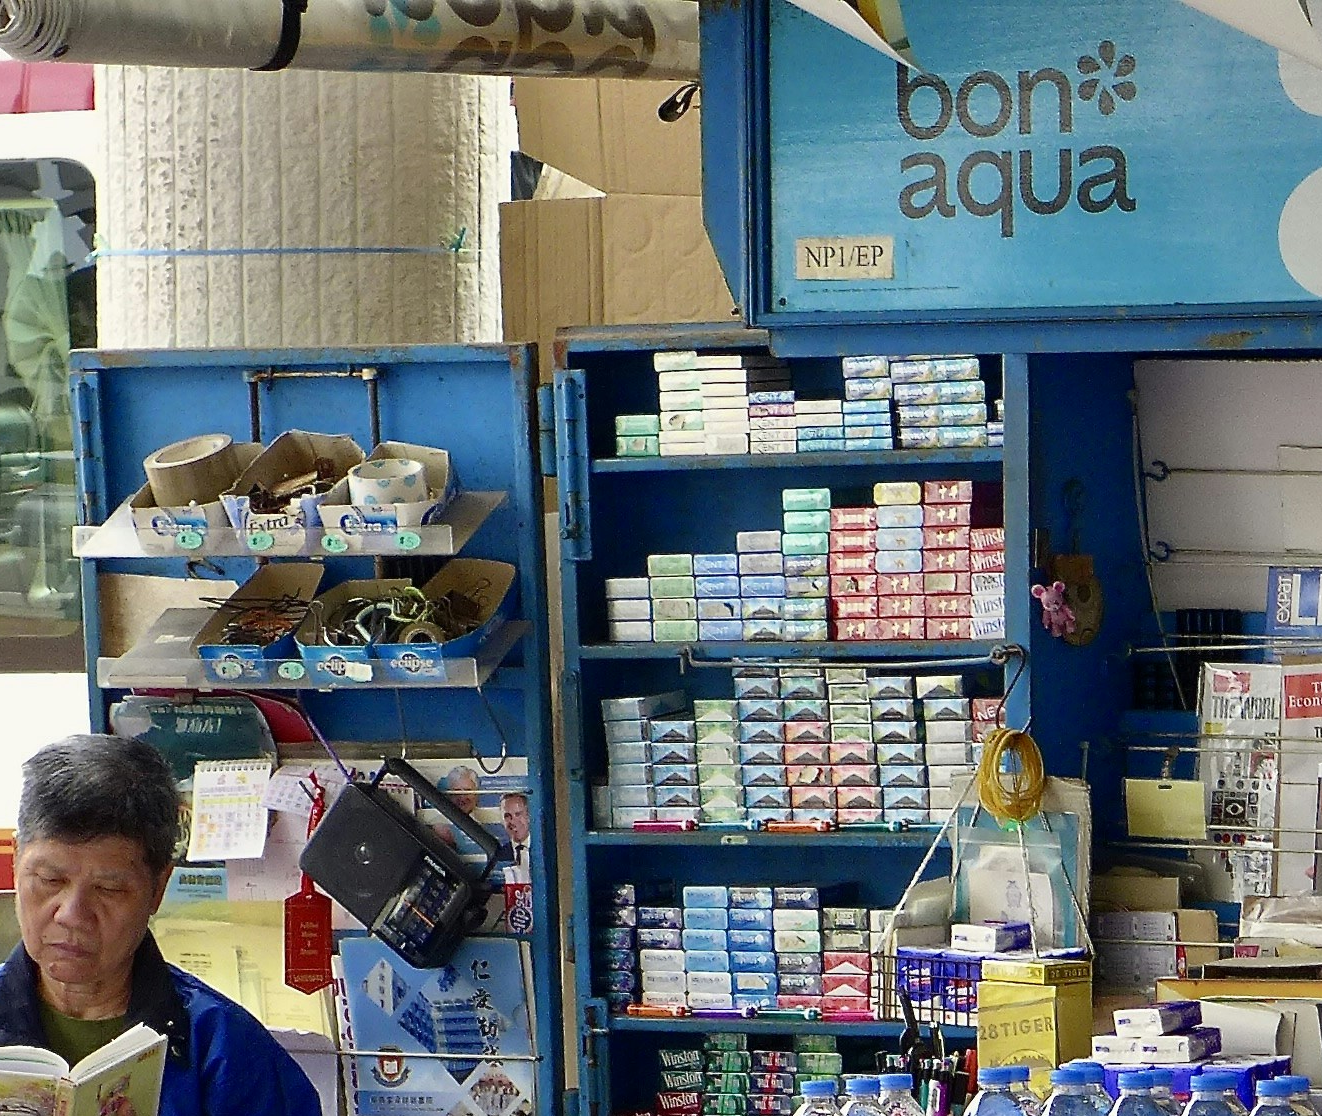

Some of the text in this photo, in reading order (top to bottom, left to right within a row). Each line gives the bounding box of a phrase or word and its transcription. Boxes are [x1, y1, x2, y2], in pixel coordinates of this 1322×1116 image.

[897, 66, 1071, 139] bon
[899, 141, 1136, 237] aqua
[806, 246, 884, 267] NP1/EP
[661, 1050, 700, 1067] Winston
[663, 1071, 702, 1088] Winston
[659, 1092, 698, 1110] Winston
